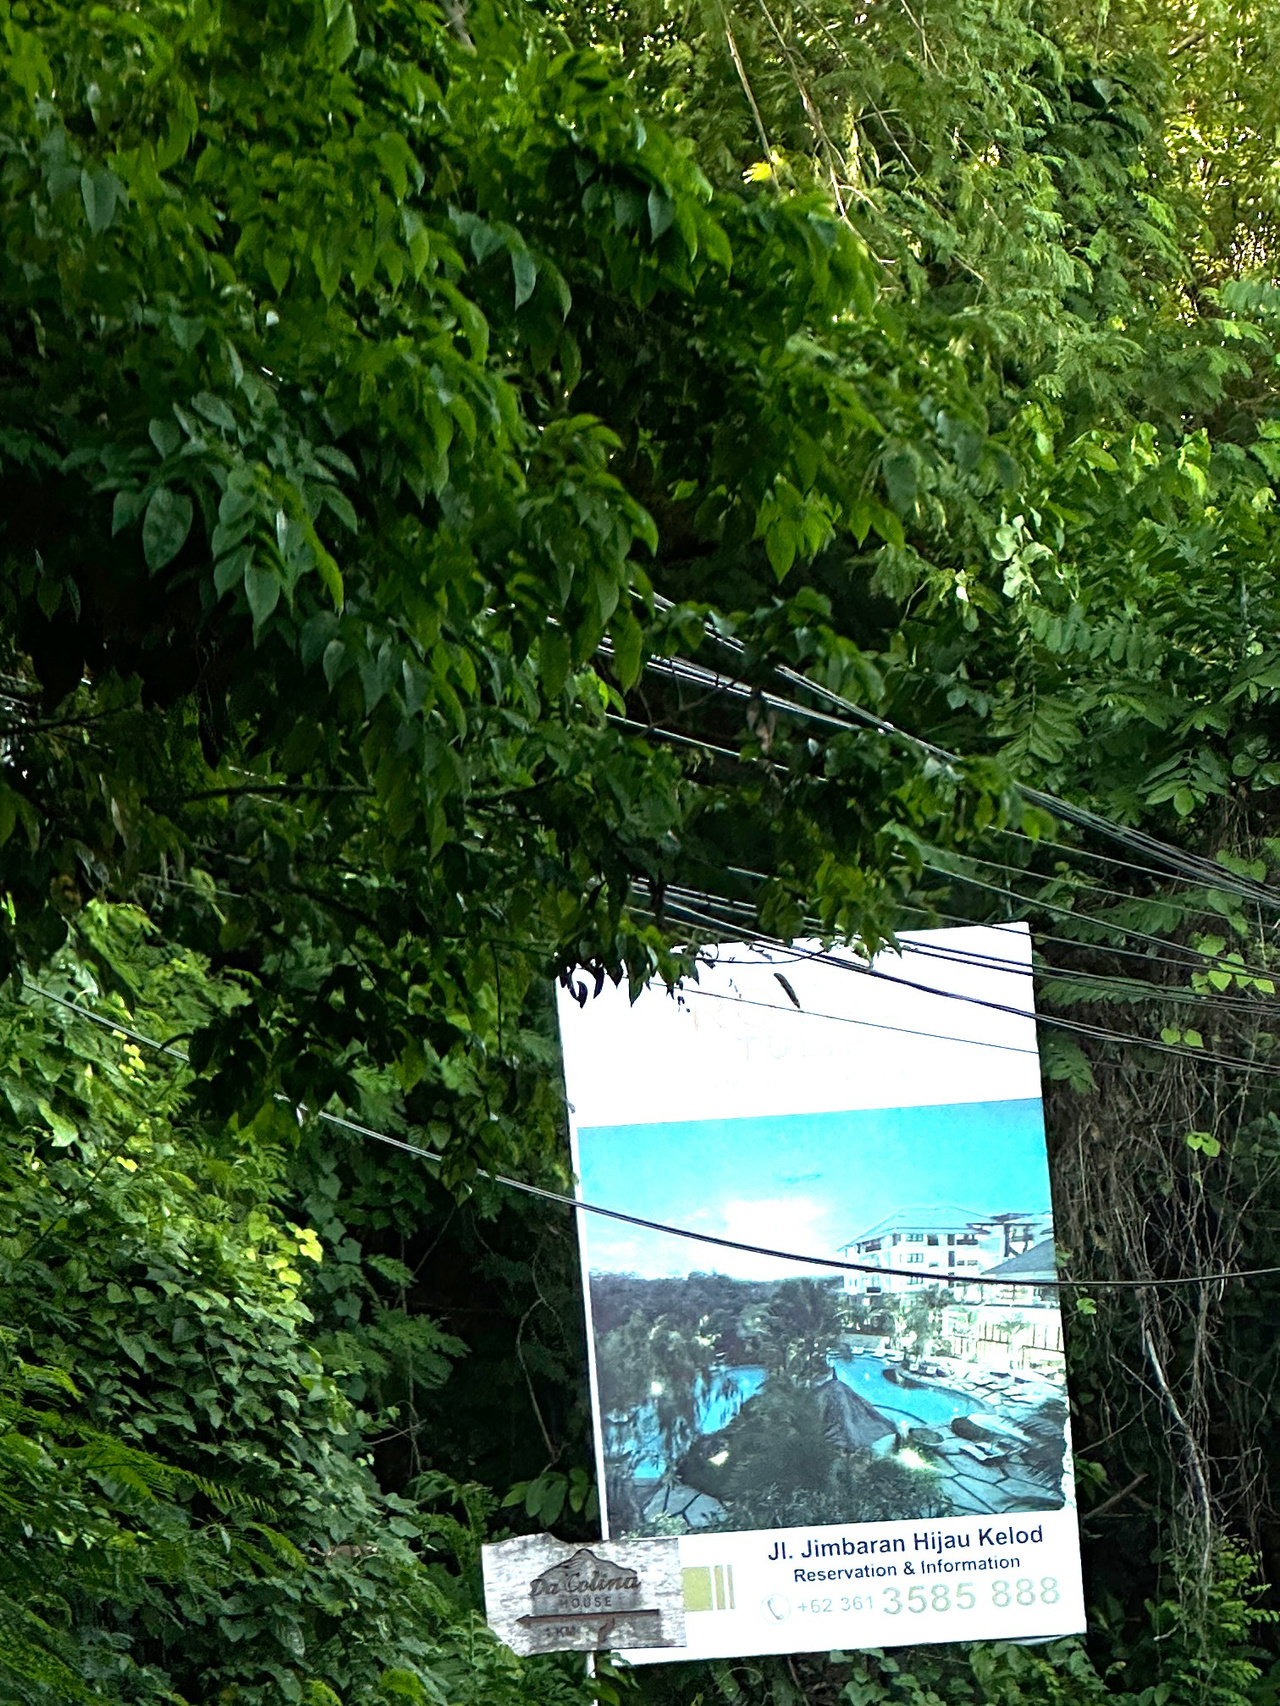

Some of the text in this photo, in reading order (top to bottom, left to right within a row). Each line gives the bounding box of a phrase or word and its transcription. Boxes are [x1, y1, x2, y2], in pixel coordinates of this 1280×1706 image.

[768, 1525, 1044, 1561] Jl. Jimbaran Hijau Kelod
[794, 1556, 1021, 1583] Reservation & Information
[560, 1595, 613, 1609] HOUSE
[797, 1576, 1061, 1615] +62 361 3585 888
